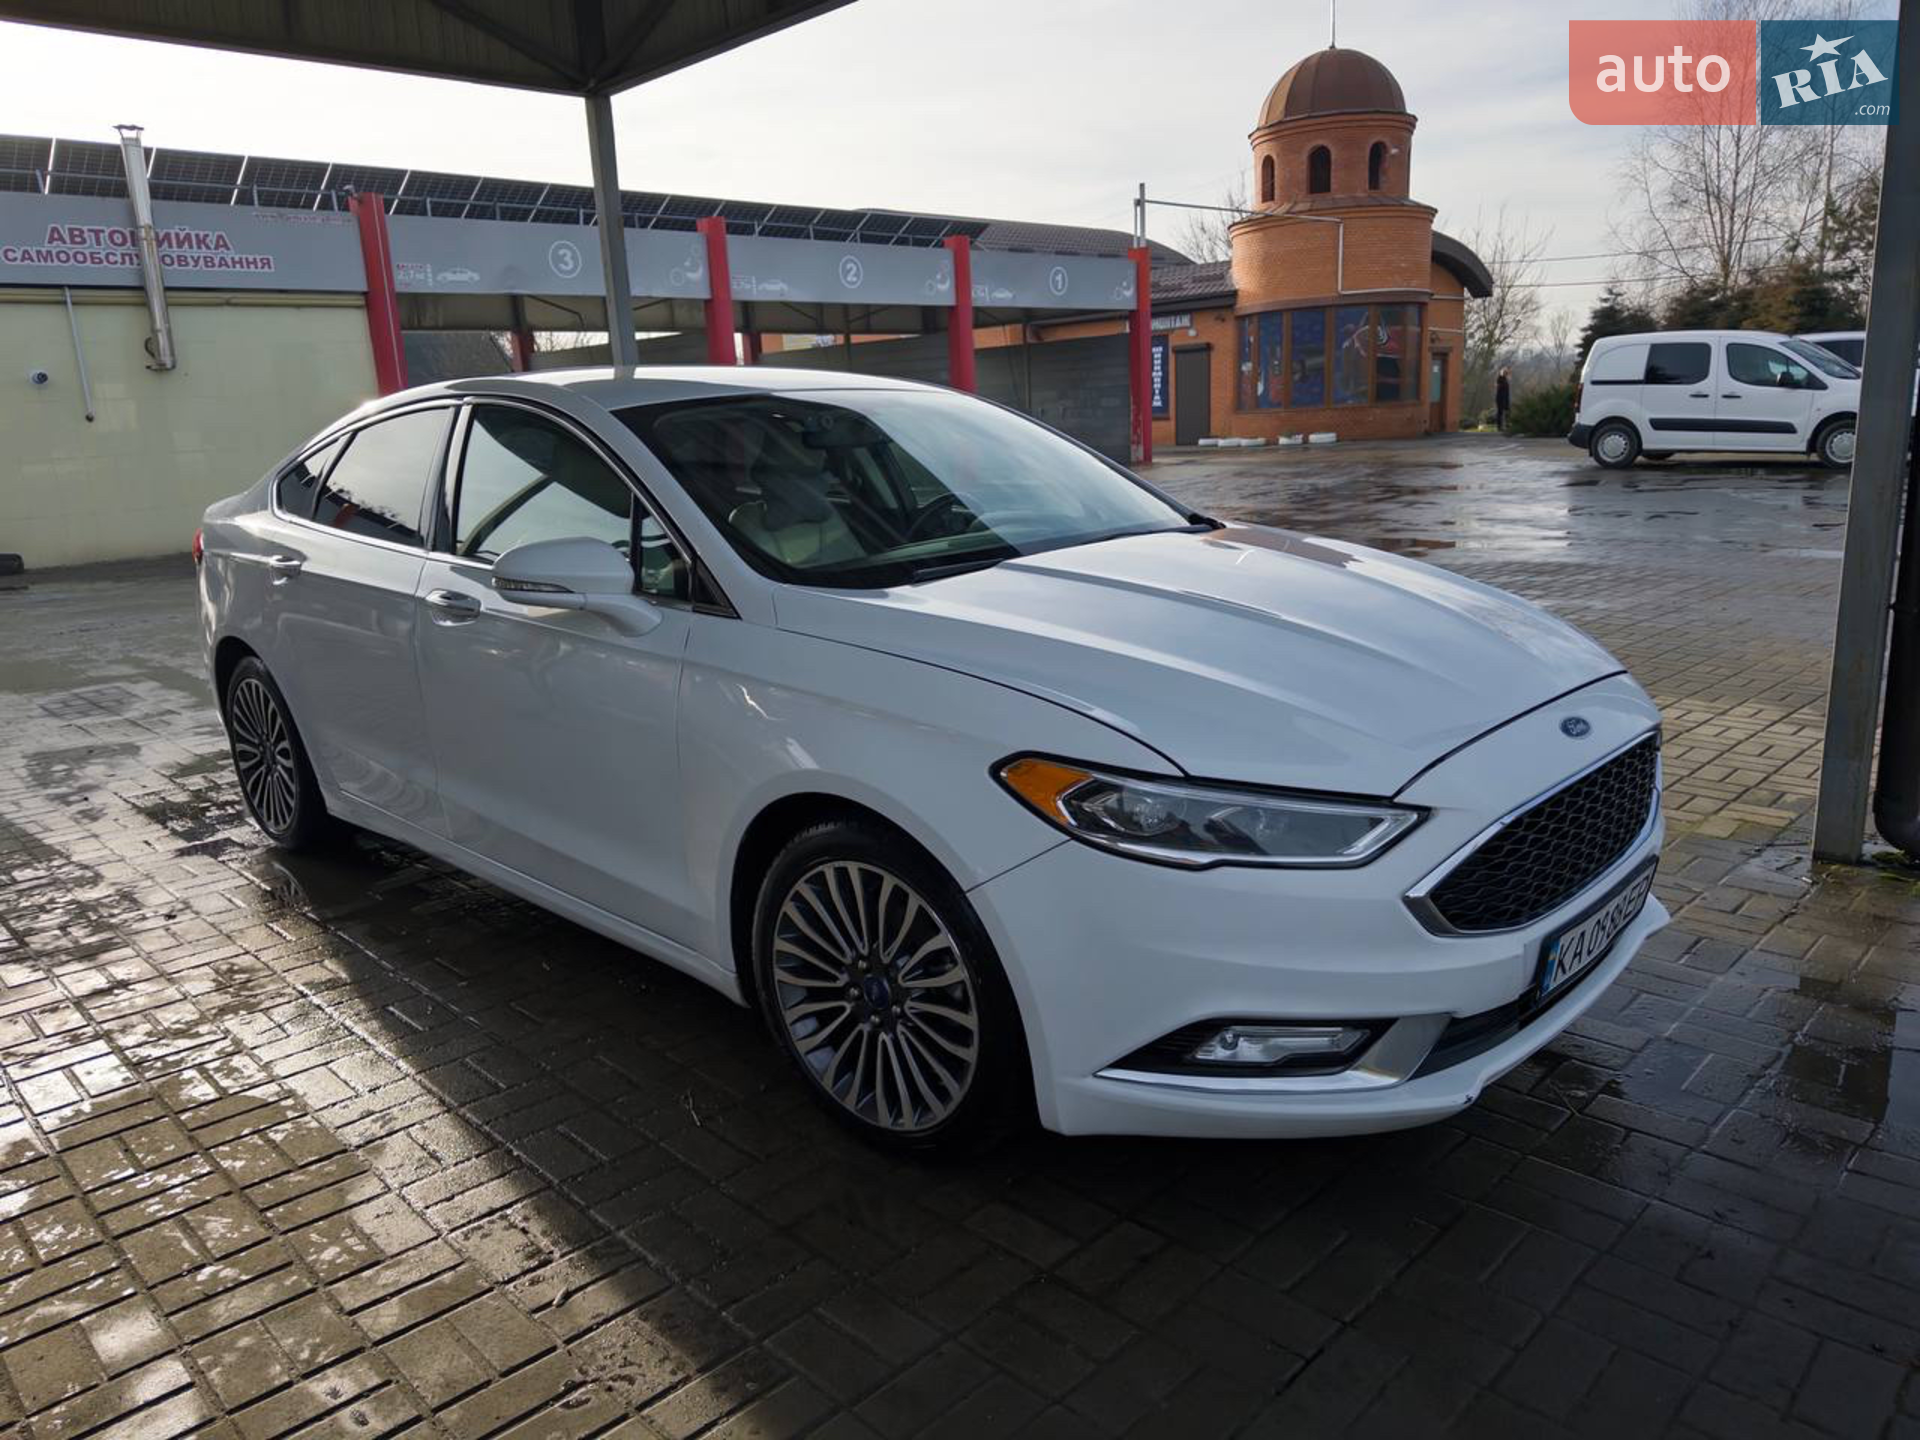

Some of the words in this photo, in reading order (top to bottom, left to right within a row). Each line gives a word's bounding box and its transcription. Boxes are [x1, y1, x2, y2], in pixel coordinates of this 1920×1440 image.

[46, 224, 231, 252] АВТОИЙКА
[2, 247, 273, 270] САМООБСЛУОВУВАННЯ
[557, 248, 574, 271] 3
[846, 262, 858, 282] 2
